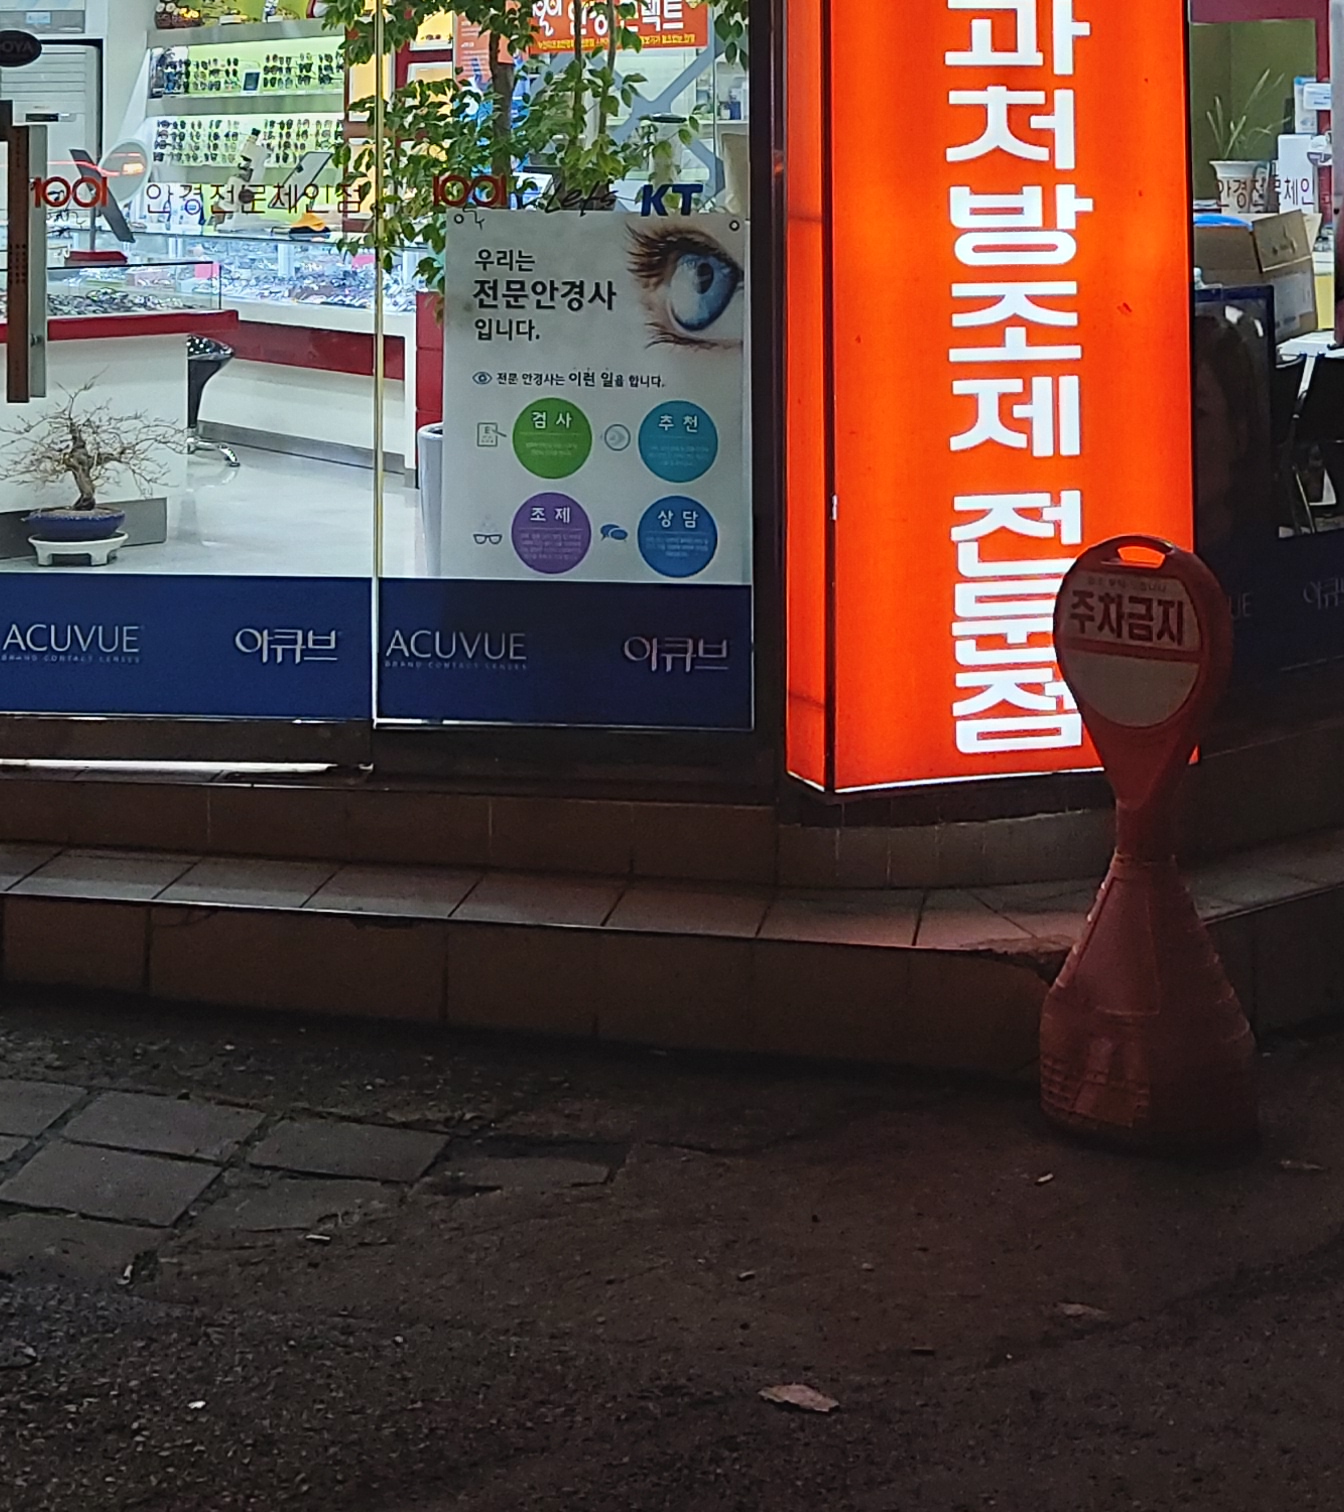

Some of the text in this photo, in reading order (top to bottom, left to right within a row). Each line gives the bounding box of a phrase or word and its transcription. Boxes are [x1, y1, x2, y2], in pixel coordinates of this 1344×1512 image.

[32, 176, 108, 208] 1001
[432, 175, 508, 208] 1001
[640, 183, 703, 217] KT
[474, 248, 536, 273] 우리는
[472, 280, 617, 311] 전문안경사
[474, 318, 542, 342] 입니다.
[496, 371, 666, 388] 전문 안경사는 이런 일을 합니다.
[532, 411, 572, 429] 검사
[657, 412, 700, 433] 추천
[530, 506, 571, 524] 조제
[657, 507, 700, 530] 상담
[1069, 591, 1184, 646] 주차금지
[1, 622, 141, 654] ACUVUE
[235, 627, 339, 664] 아큐브
[386, 629, 528, 661] ACUVUE
[622, 634, 731, 676] 아큐브
